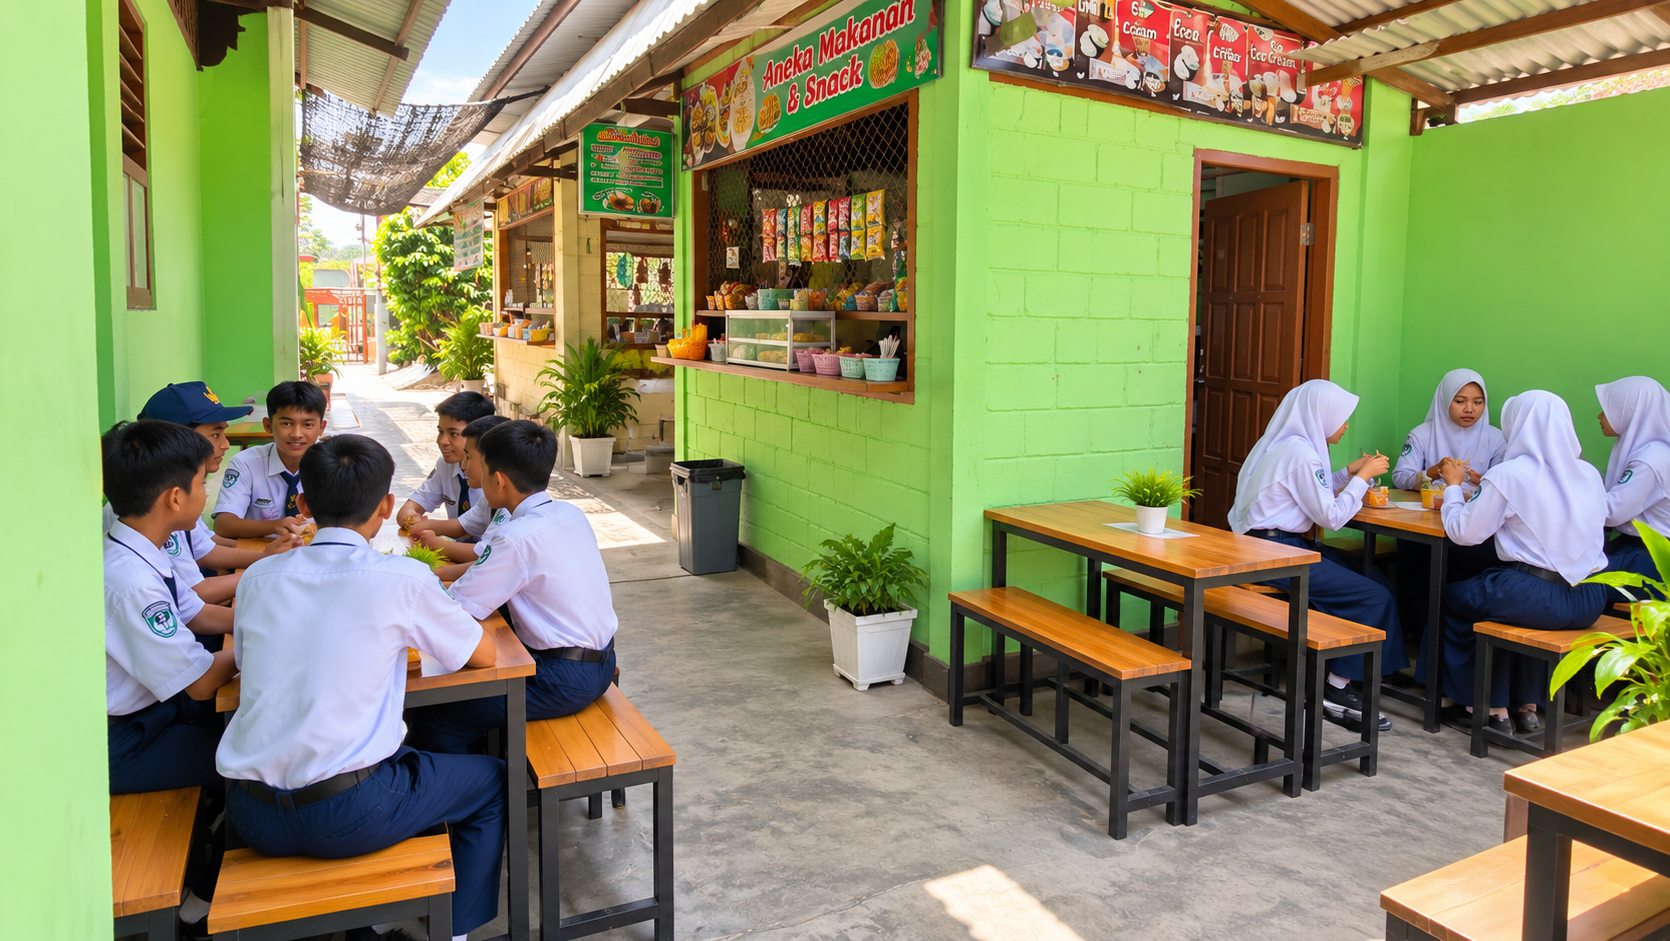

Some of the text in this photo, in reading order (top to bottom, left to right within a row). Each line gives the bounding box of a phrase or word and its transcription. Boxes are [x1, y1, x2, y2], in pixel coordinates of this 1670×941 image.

[763, 0, 916, 92] Aneka Makanan
[787, 54, 864, 115] & Snack
